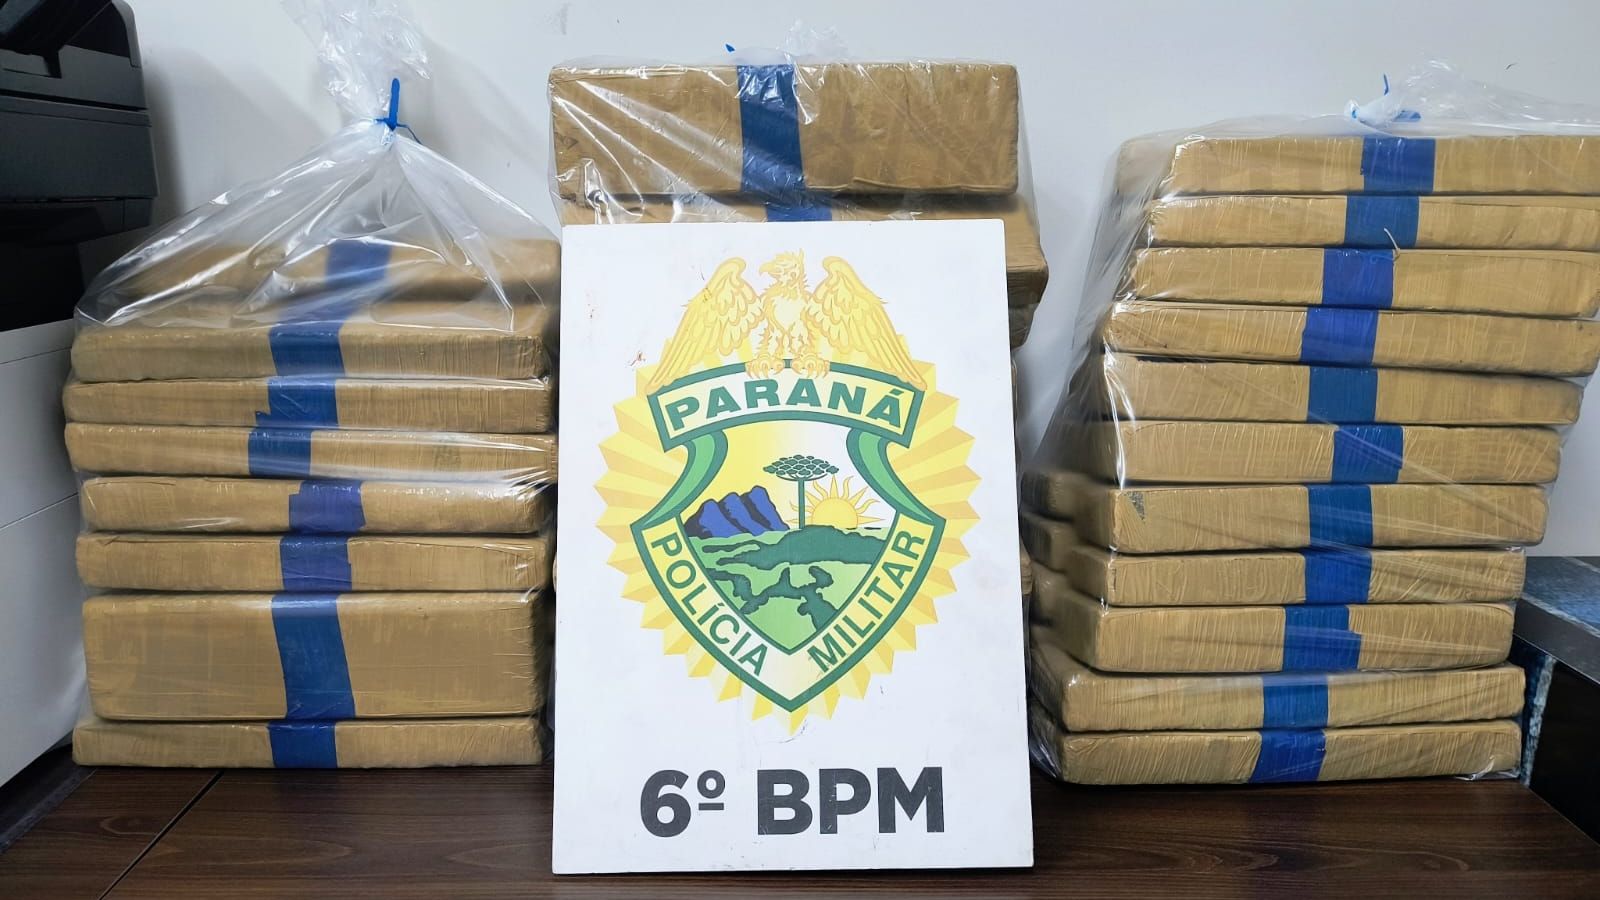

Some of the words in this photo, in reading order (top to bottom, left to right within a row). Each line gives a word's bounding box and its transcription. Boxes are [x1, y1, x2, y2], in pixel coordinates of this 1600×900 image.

[666, 379, 906, 430] PARANÁ
[651, 533, 769, 676] POLÍCIA
[808, 531, 926, 673] MILITAR
[757, 767, 945, 836] BPM
